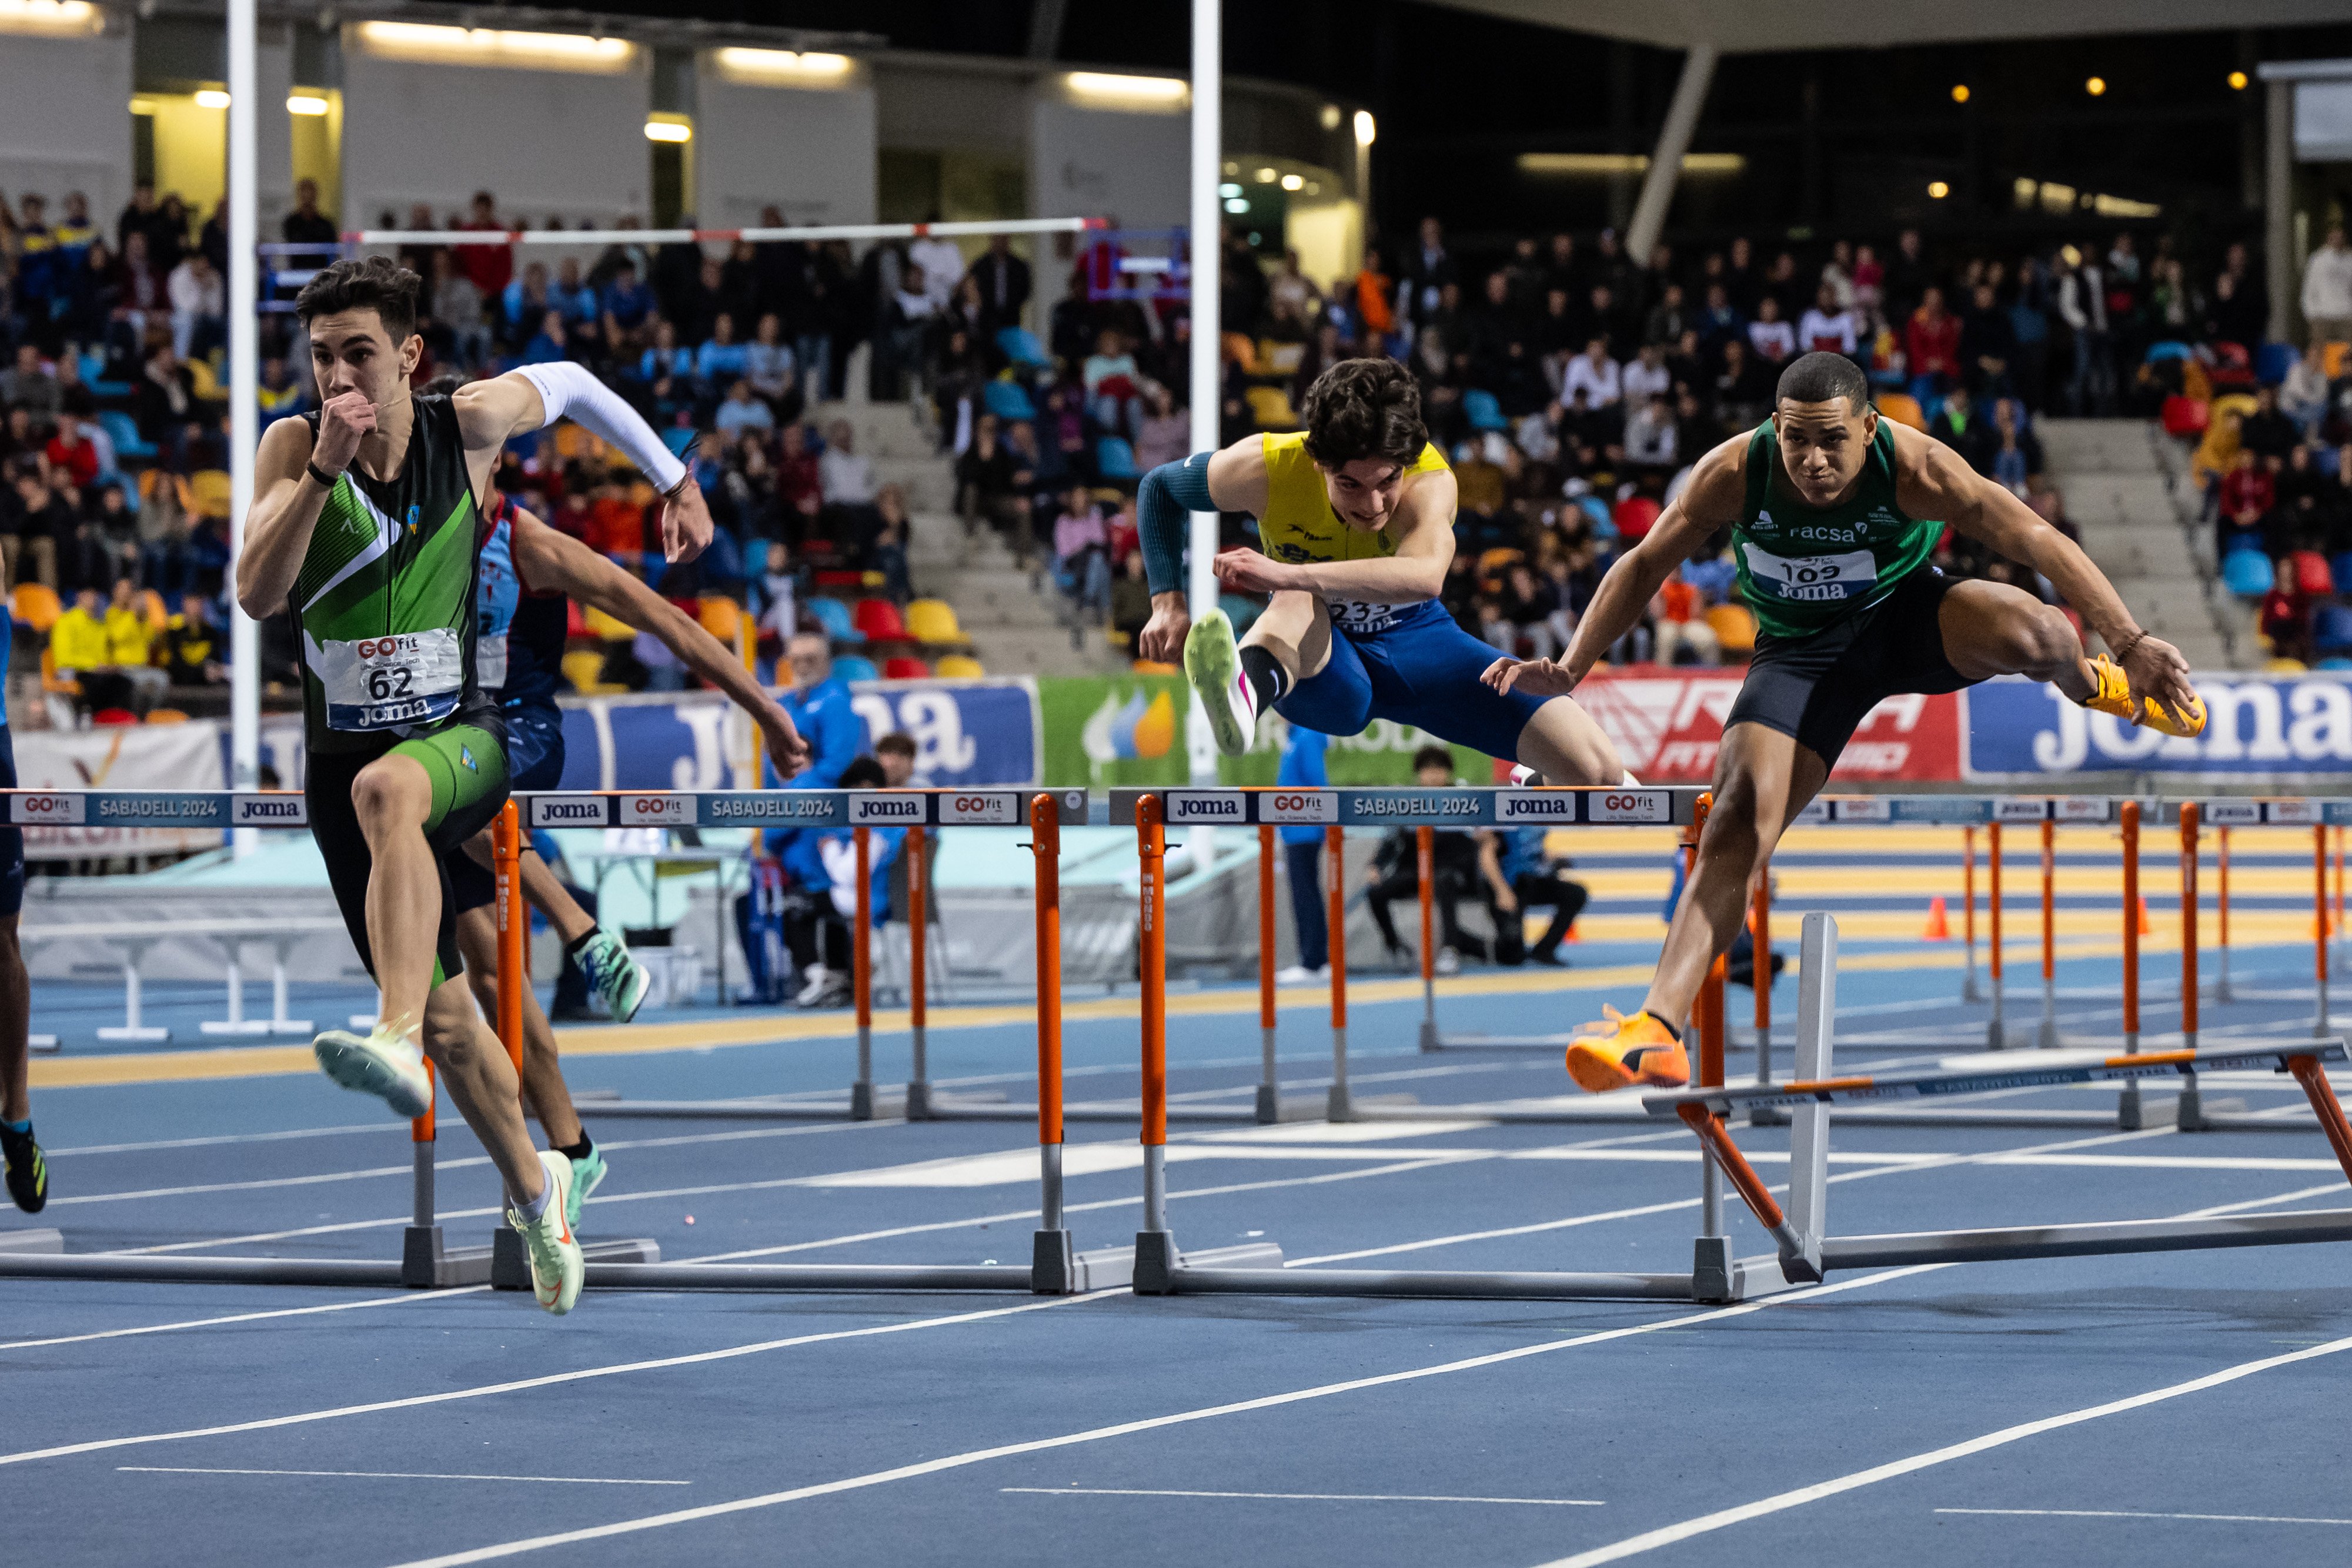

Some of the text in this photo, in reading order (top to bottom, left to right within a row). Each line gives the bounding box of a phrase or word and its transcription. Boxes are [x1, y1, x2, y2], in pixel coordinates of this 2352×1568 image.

[1789, 526, 1856, 543] racsa
[1780, 561, 1840, 583] 109
[369, 667, 414, 700] 62
[99, 800, 218, 817] SABADELL 2024
[711, 799, 834, 817] SABADELL 2024
[1354, 797, 1481, 815] SABADELL 2024
